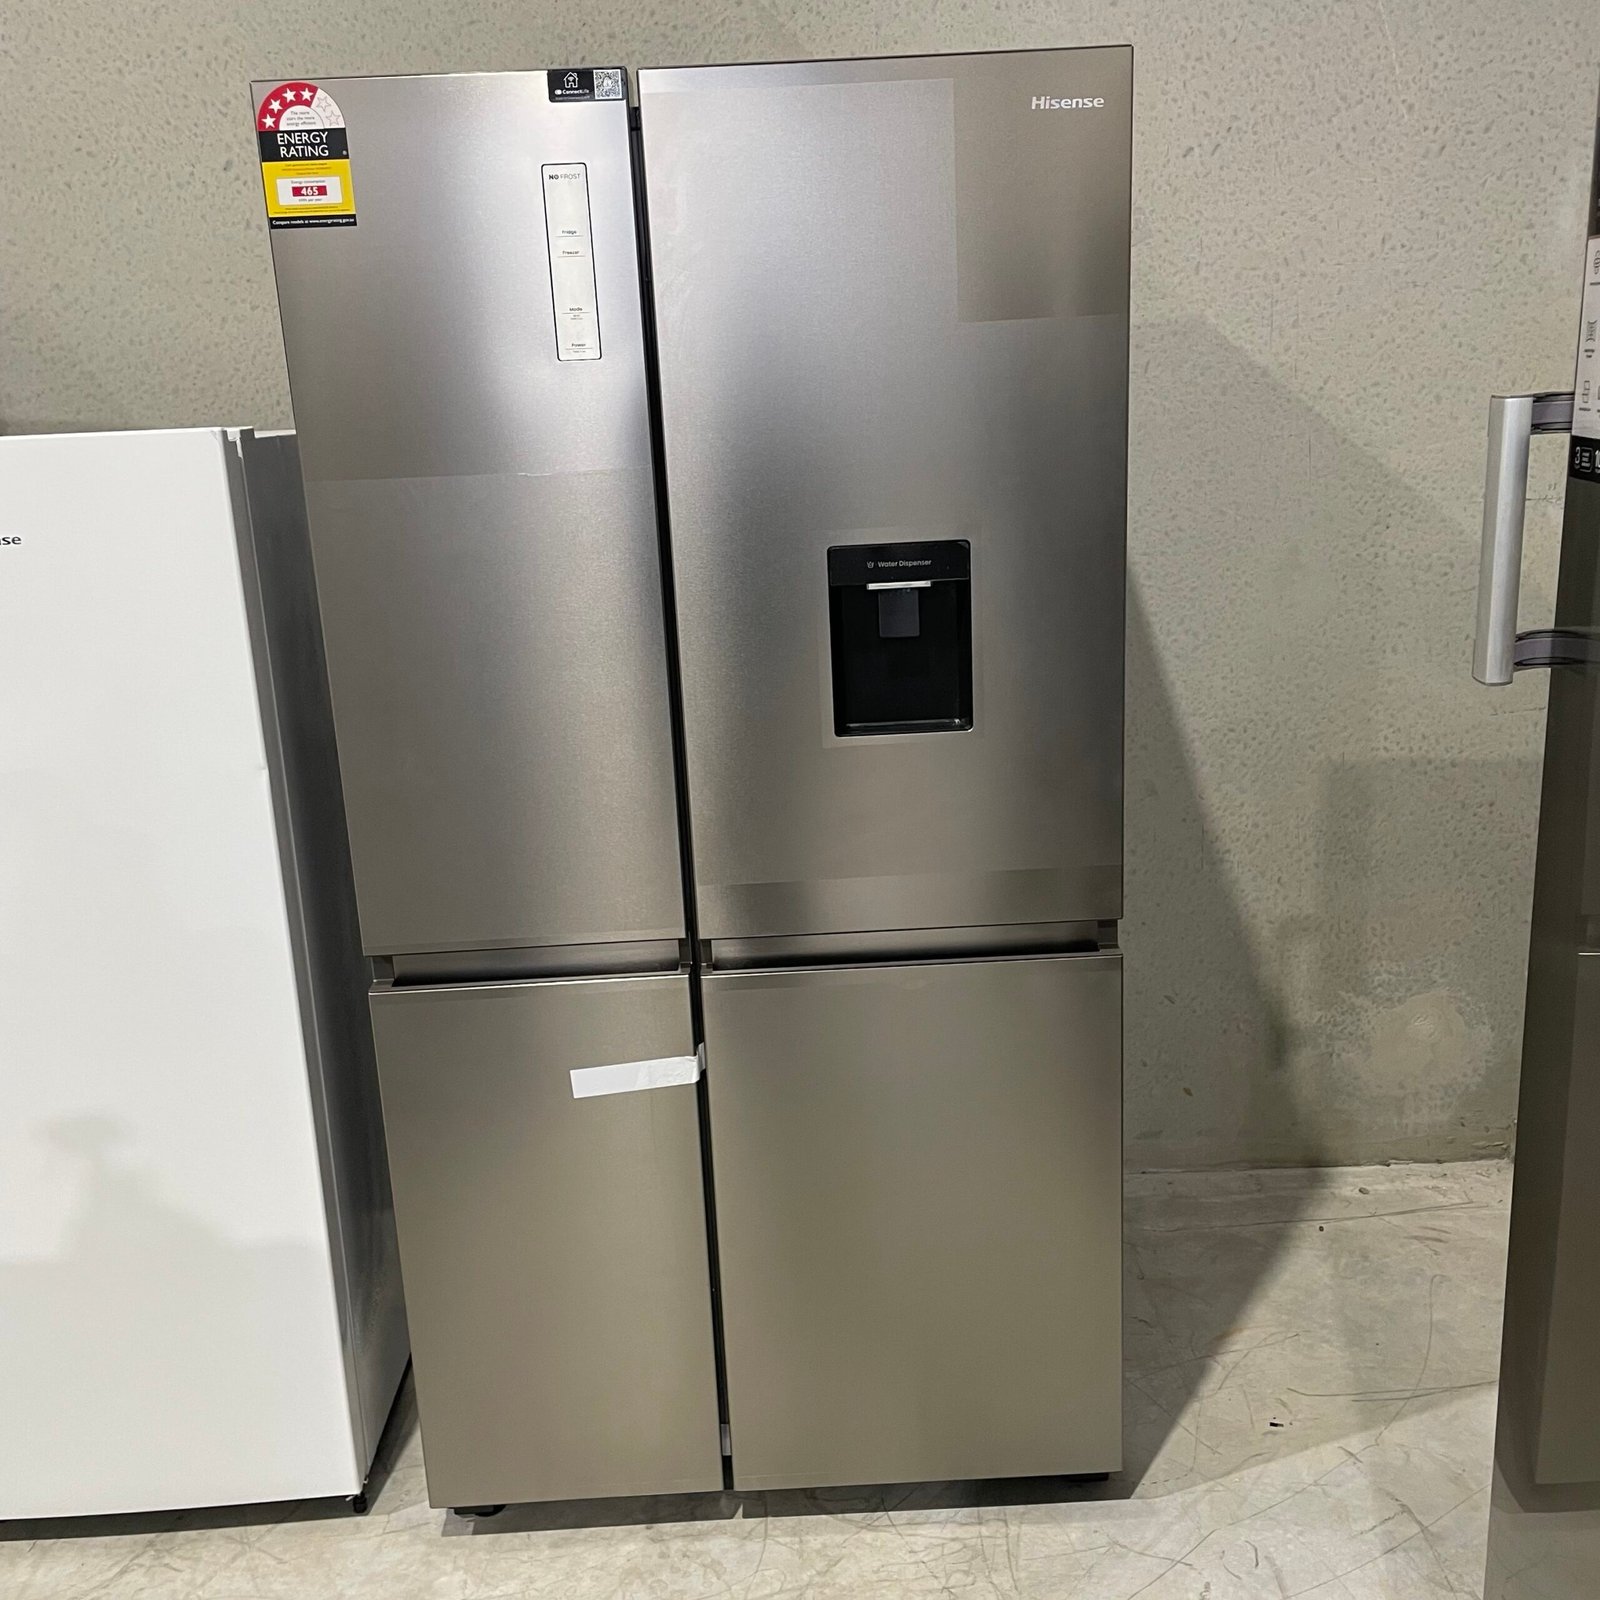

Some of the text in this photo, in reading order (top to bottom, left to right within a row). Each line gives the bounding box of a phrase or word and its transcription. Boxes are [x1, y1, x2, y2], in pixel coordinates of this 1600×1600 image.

[1031, 95, 1105, 110] Hisense
[276, 131, 329, 145] ENERGY
[279, 145, 329, 158] RATING
[300, 187, 319, 196] 465
